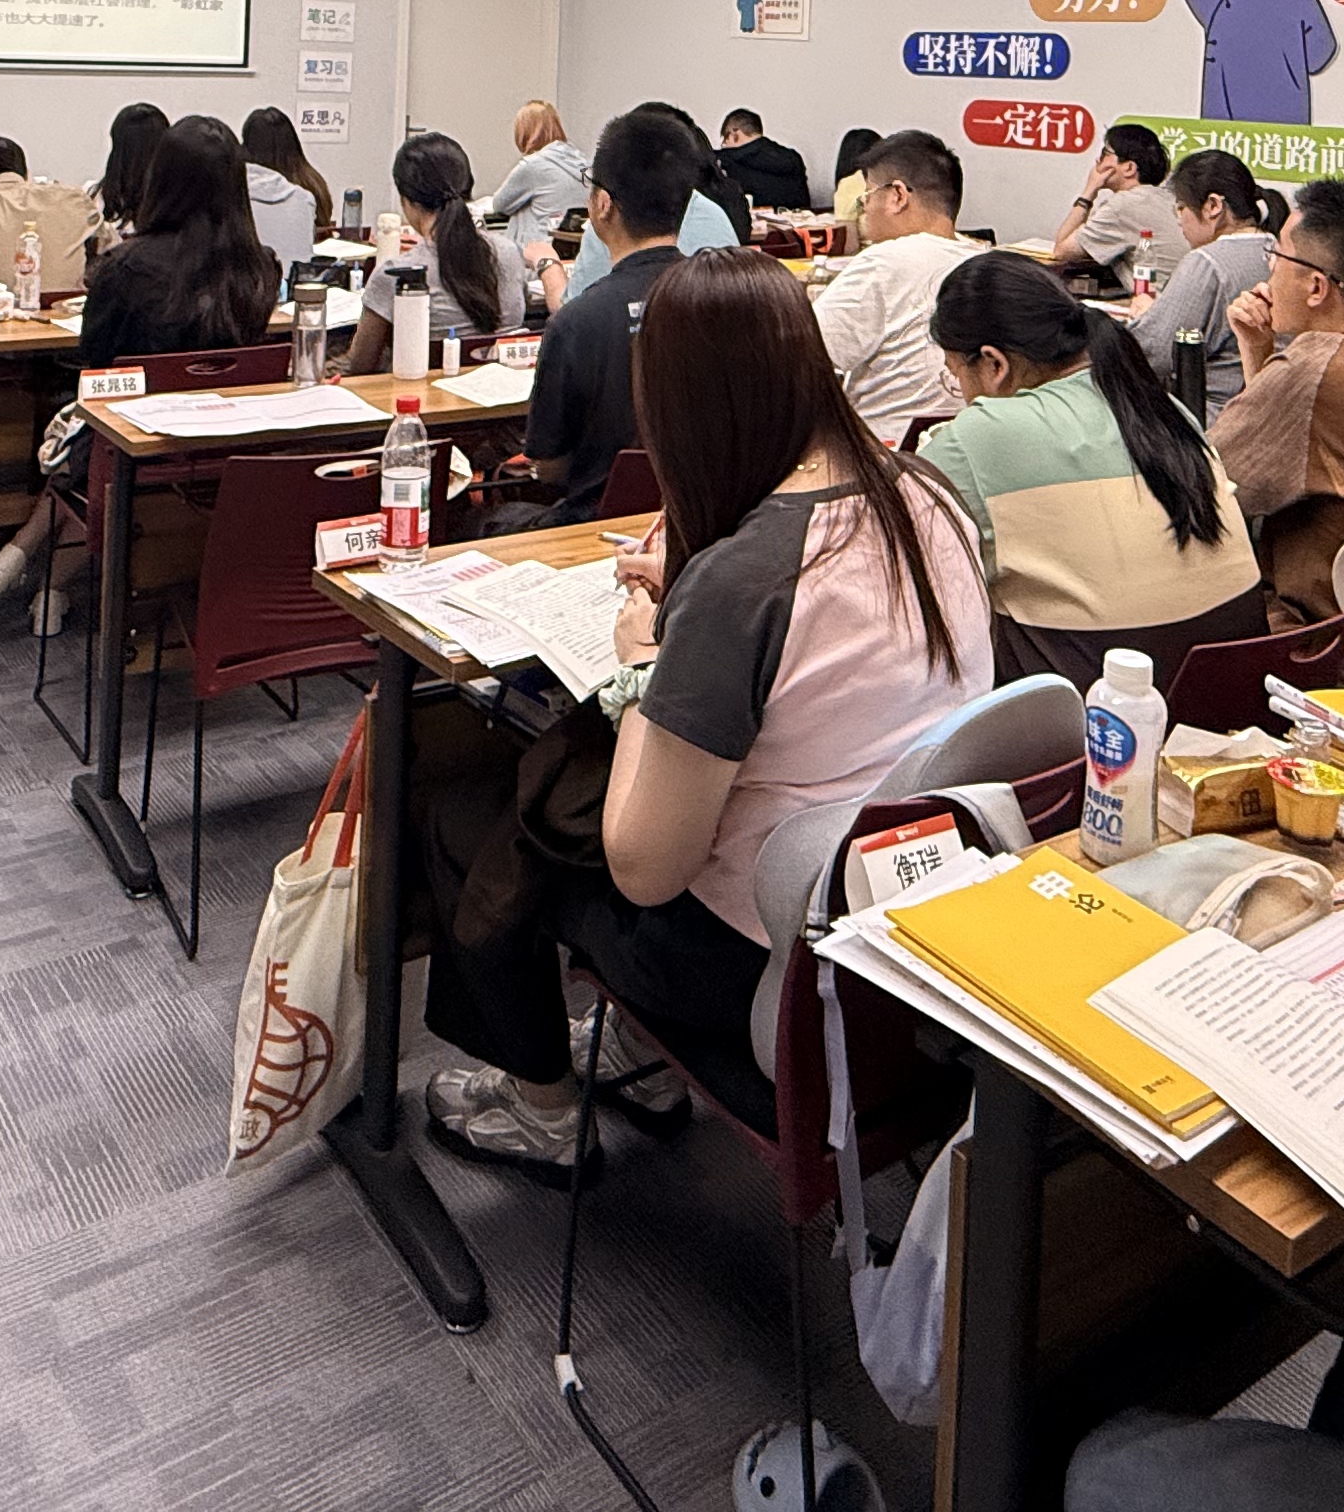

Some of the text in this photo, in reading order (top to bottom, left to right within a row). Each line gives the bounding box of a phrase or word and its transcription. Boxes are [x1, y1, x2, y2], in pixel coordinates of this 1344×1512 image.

[307, 8, 336, 25] 笔记
[304, 59, 333, 75] 复习
[916, 35, 1054, 78] 坚持不懈！
[301, 110, 330, 126] 反思
[972, 105, 1085, 149] 一定行！
[1028, 870, 1105, 915] 申论
